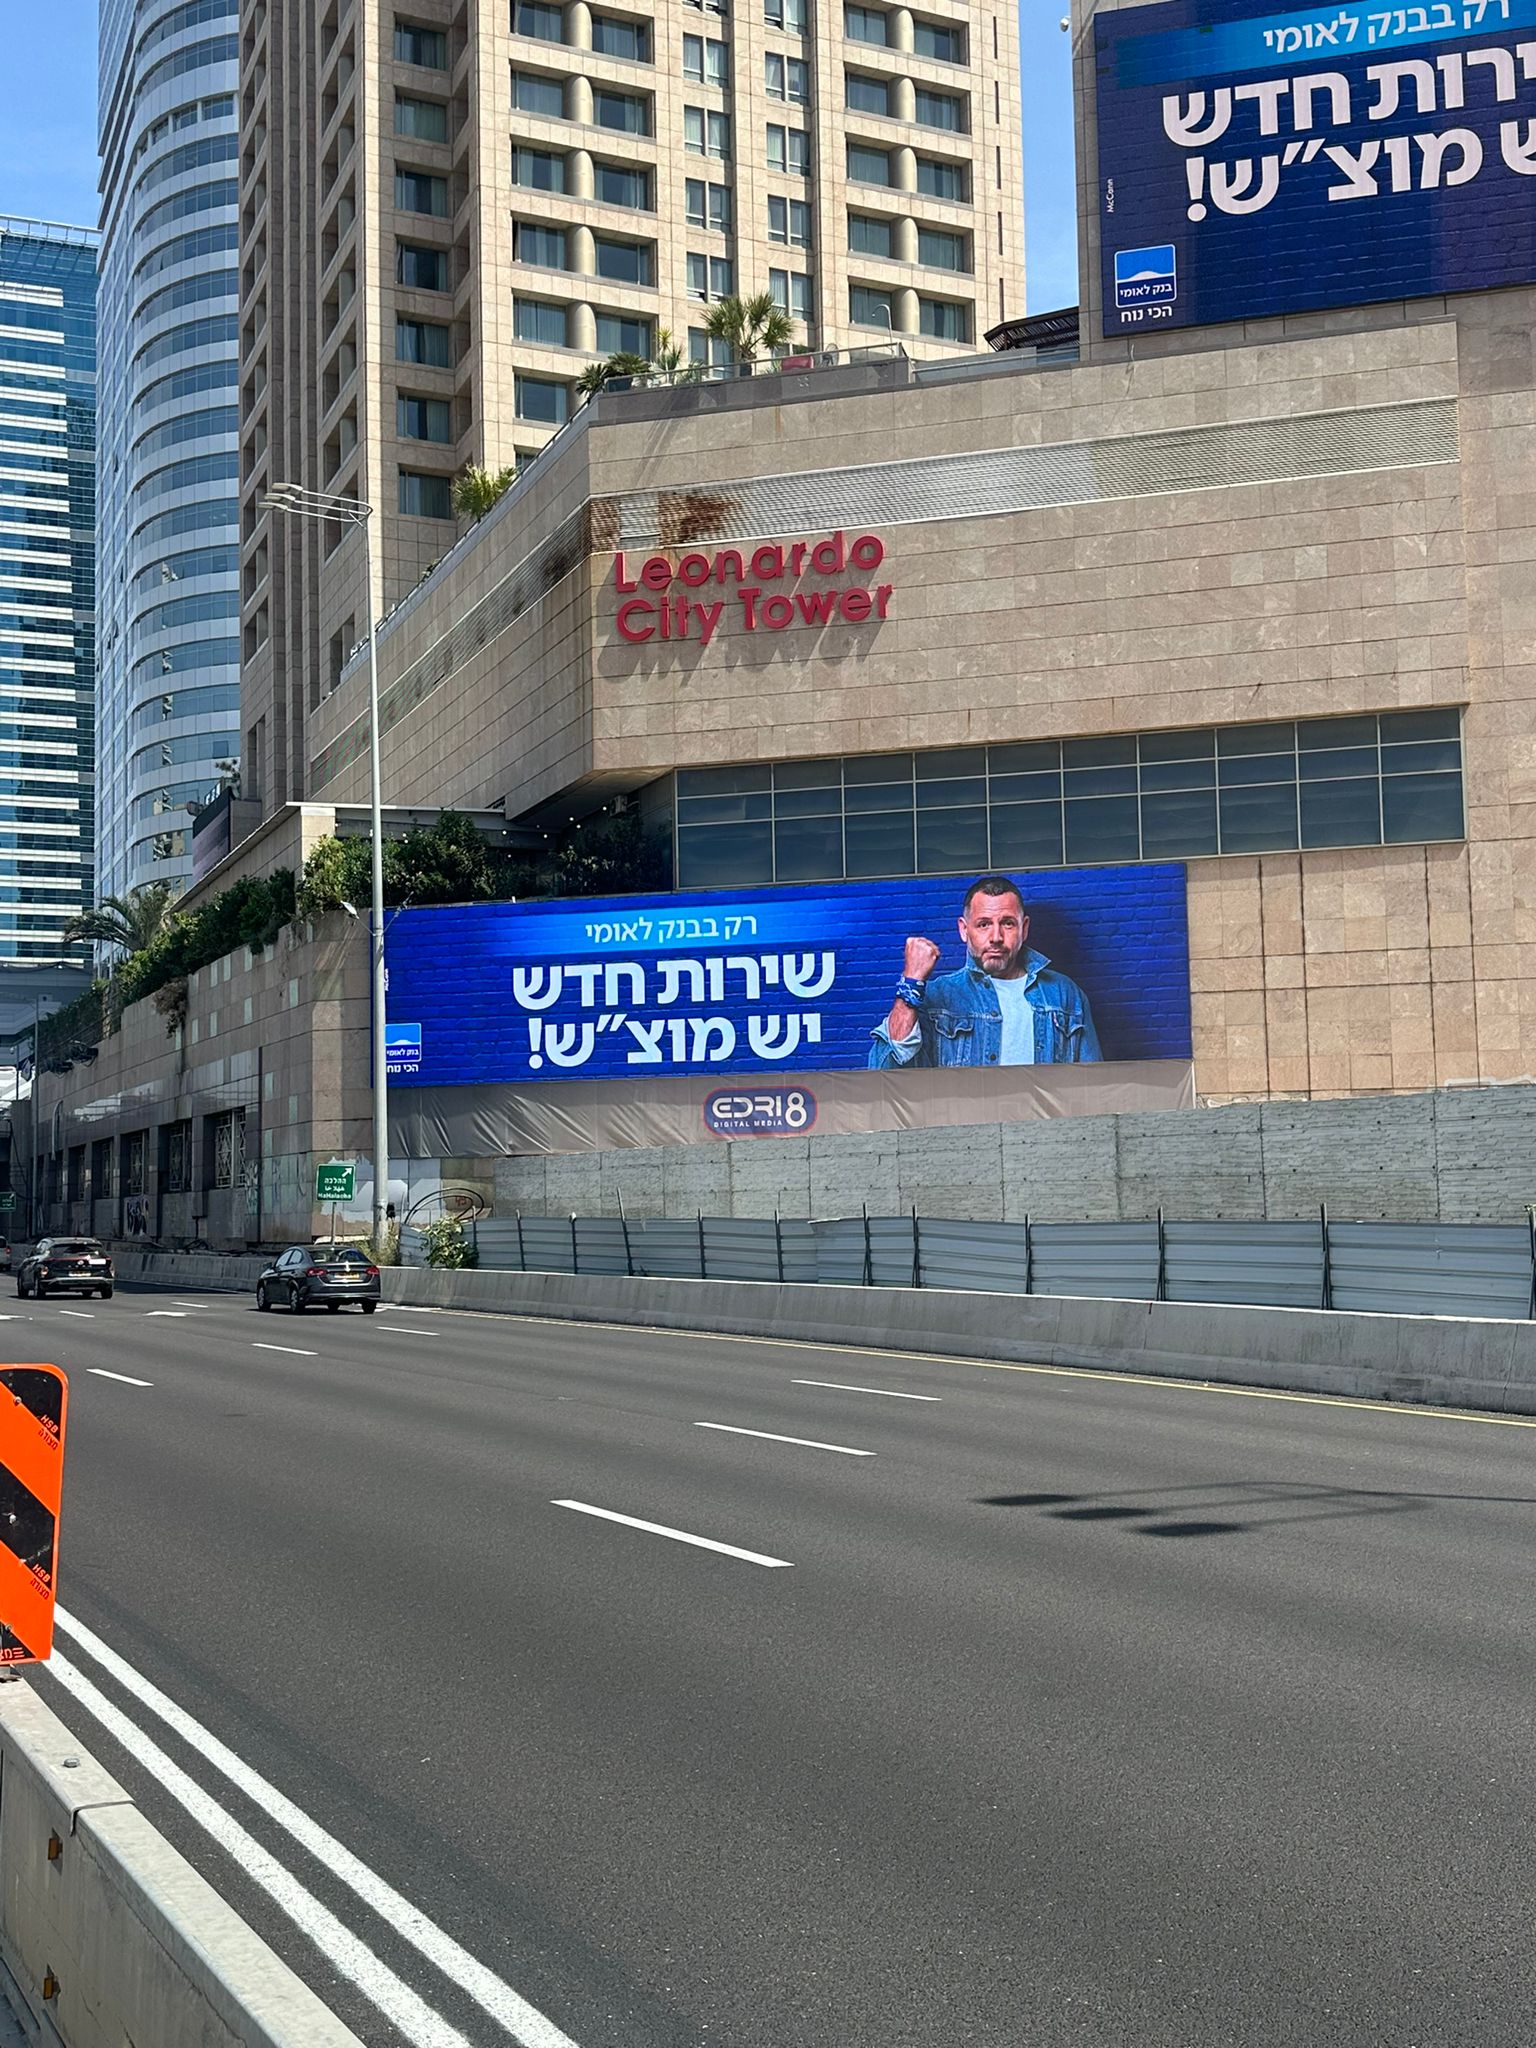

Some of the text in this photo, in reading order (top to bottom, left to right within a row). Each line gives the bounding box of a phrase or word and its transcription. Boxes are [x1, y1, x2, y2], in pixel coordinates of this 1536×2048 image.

[1263, 0, 1510, 53] רק בבנק לאומי
[1162, 41, 1536, 147] ירות חדש
[1105, 179, 1115, 213] McCann
[1120, 283, 1173, 298] בנק לאומי
[1121, 306, 1173, 323] הכי נוח
[615, 530, 884, 593] Leonardo
[616, 584, 893, 645] City Tower
[585, 915, 757, 944] רק בבנק לאומי
[512, 952, 836, 1010] שירות חדש
[747, 1012, 821, 1060] יש
[713, 1119, 783, 1128] DIGITAL MEDIA
[40, 1414, 59, 1434] HSB
[32, 1563, 51, 1583] HSB
